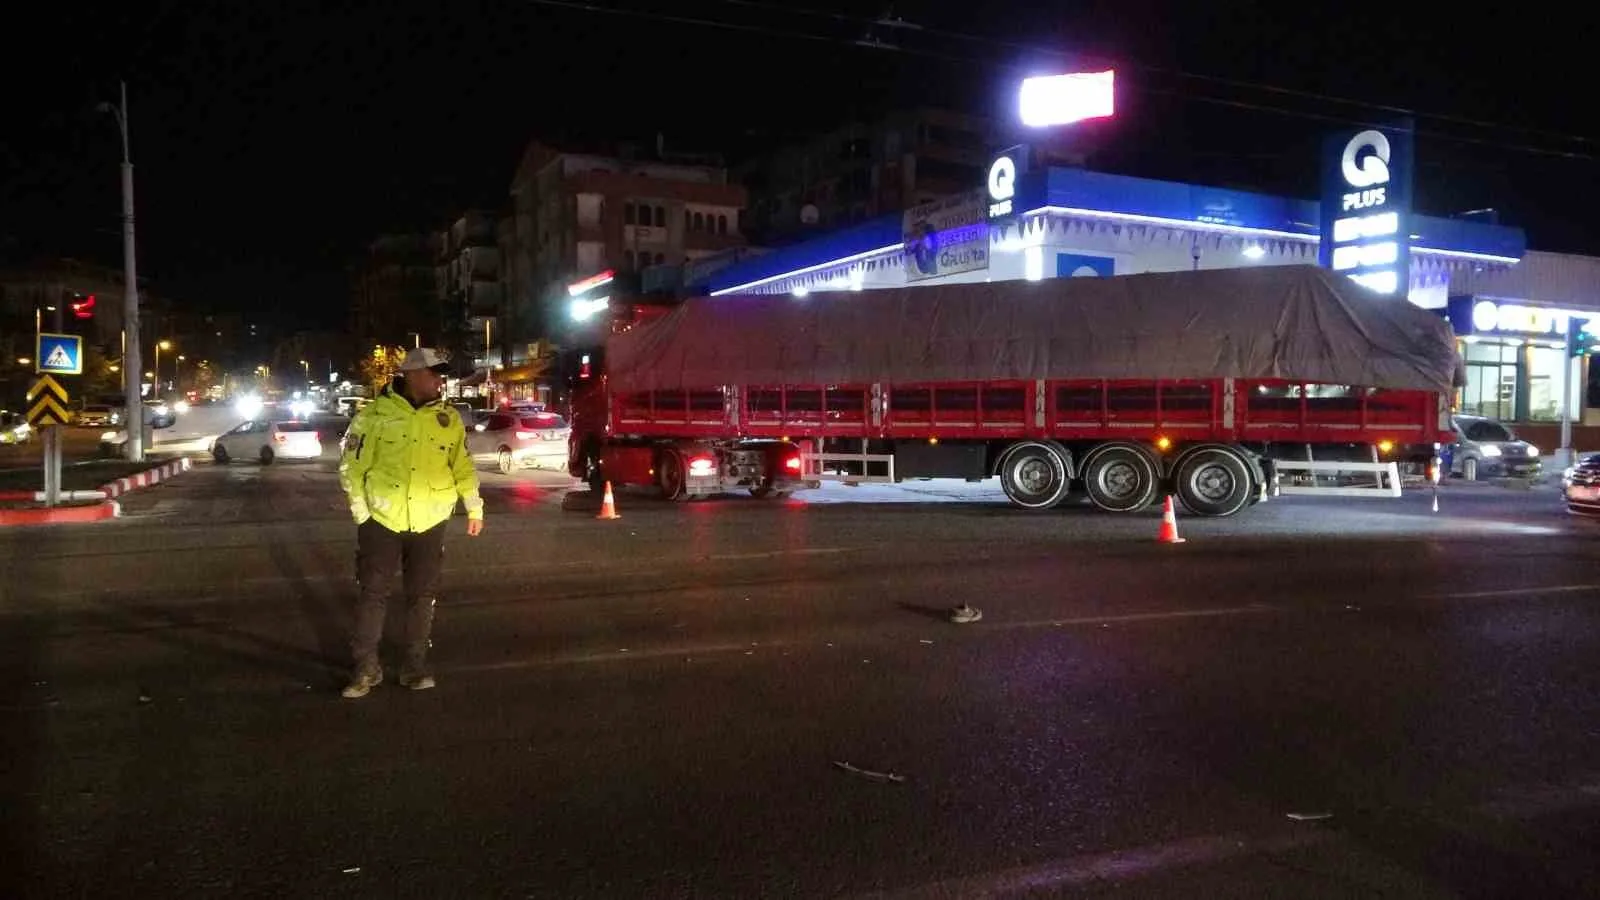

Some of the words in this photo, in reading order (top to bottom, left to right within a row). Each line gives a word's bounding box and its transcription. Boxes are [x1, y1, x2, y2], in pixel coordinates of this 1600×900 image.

[988, 155, 1016, 201] Q
[1341, 129, 1391, 188] Q
[1343, 187, 1386, 211] PLUS
